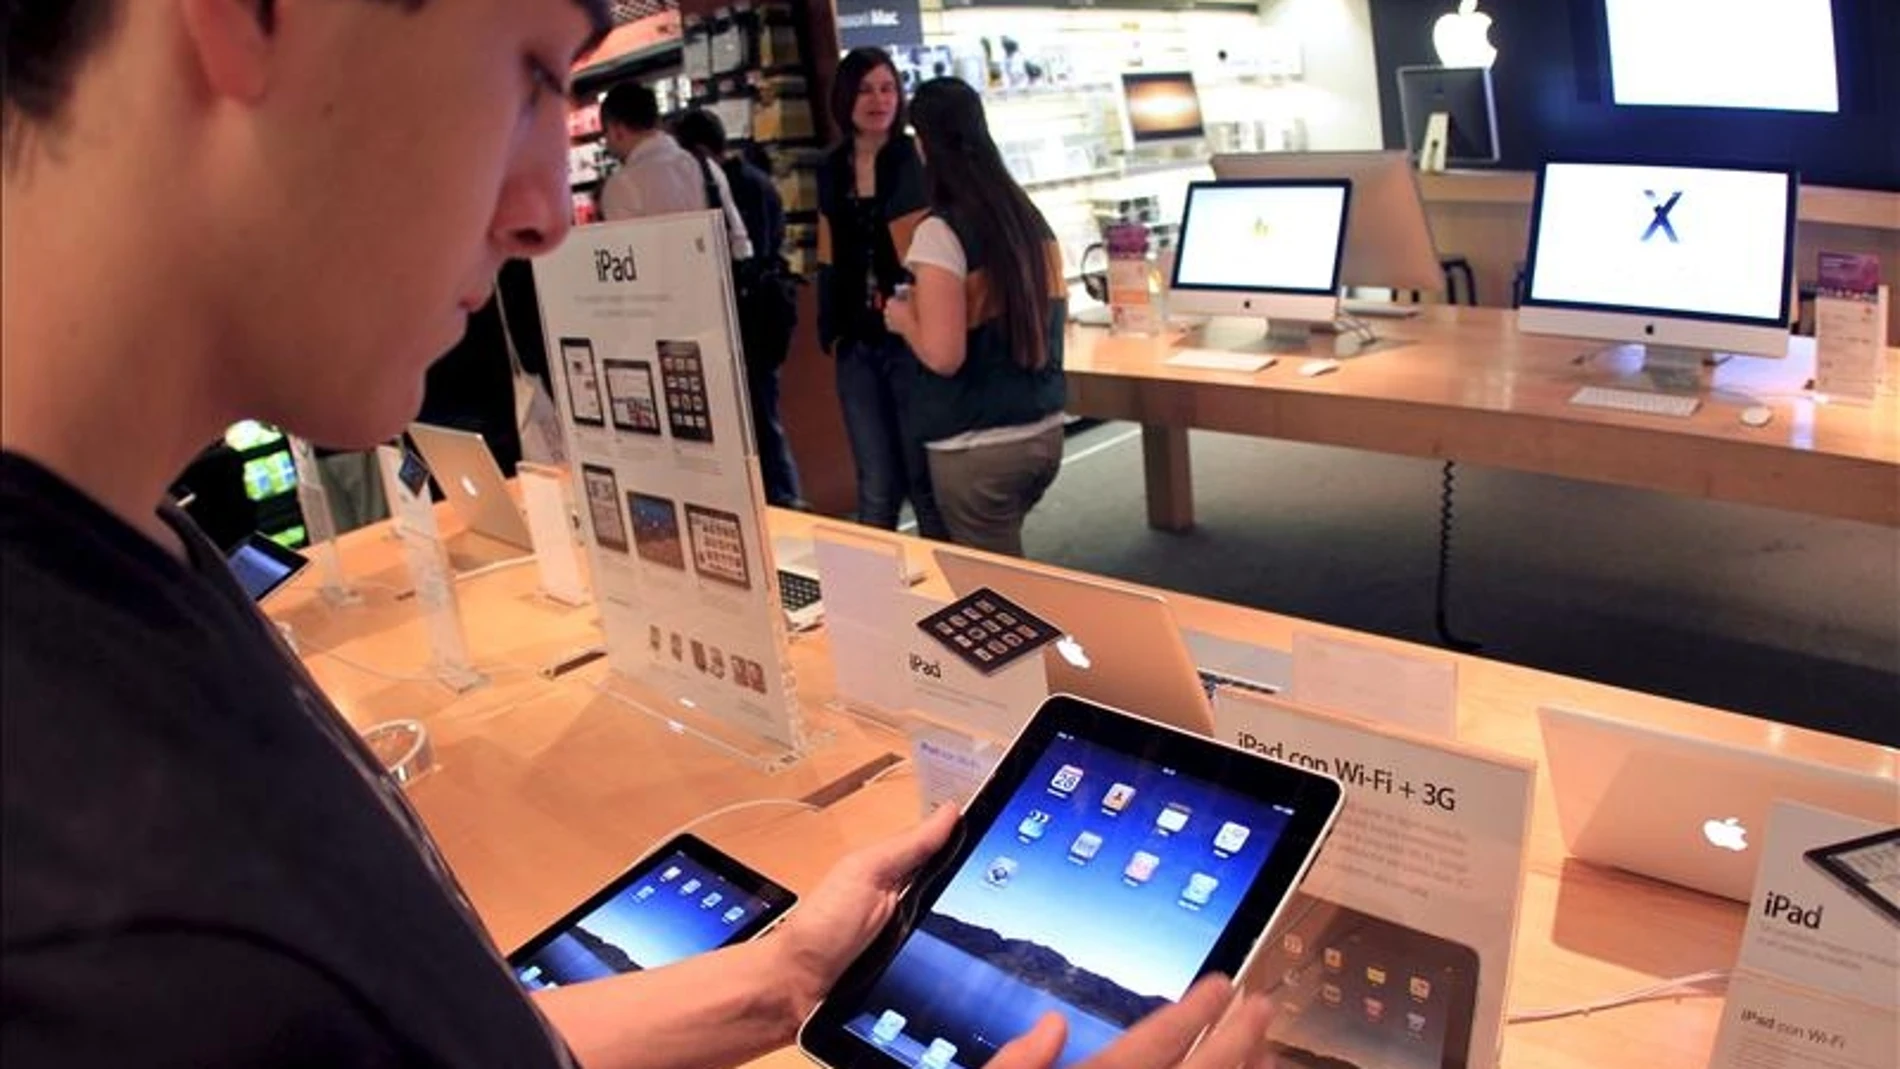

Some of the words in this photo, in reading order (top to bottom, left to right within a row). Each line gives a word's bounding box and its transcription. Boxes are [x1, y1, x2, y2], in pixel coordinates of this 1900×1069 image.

[594, 247, 638, 282] iPad
[909, 651, 942, 678] iPad
[1334, 757, 1393, 794] Wi-Fi
[1399, 781, 1416, 799] +
[1422, 782, 1456, 811] 3G
[1763, 891, 1824, 930] iPad
[1741, 1007, 1775, 1030] iPad
